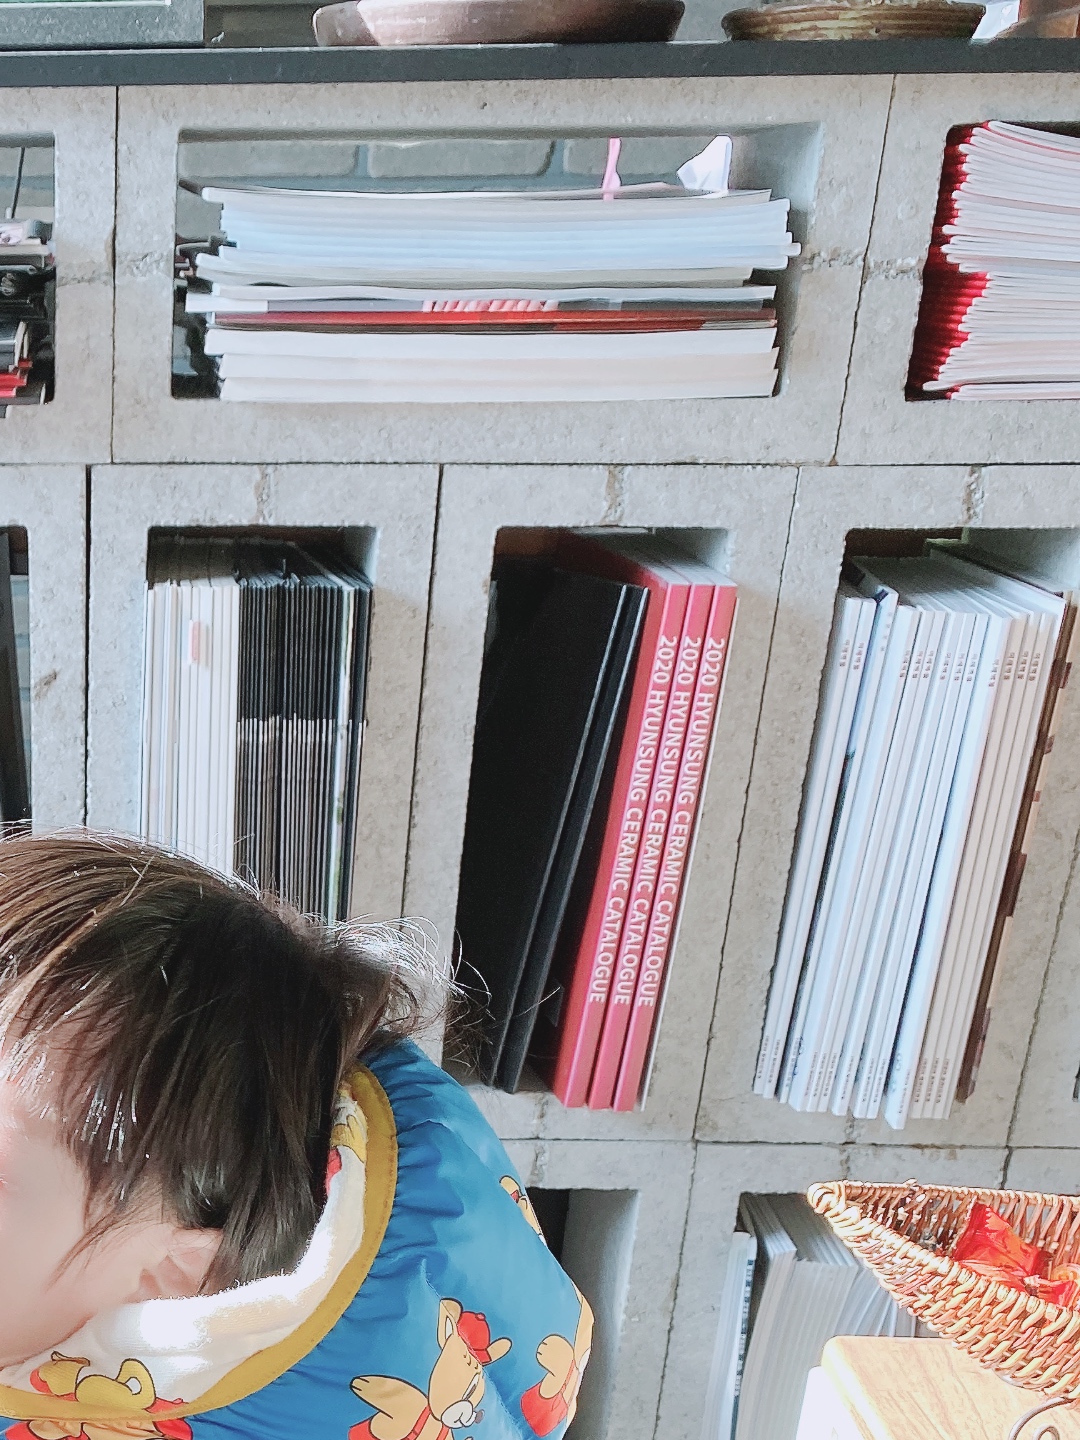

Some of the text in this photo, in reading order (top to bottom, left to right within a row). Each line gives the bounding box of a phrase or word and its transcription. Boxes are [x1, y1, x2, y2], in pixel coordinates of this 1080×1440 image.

[589, 635, 677, 1002] 2020 HYUNSUNG CERAMIC CATALOGUE
[614, 637, 701, 1005] 2020 HYUNSUNG CERAMIC CATALOGUE
[637, 638, 725, 1007] 2020 HYUNSUNG CERAMIC CATALOGUE
